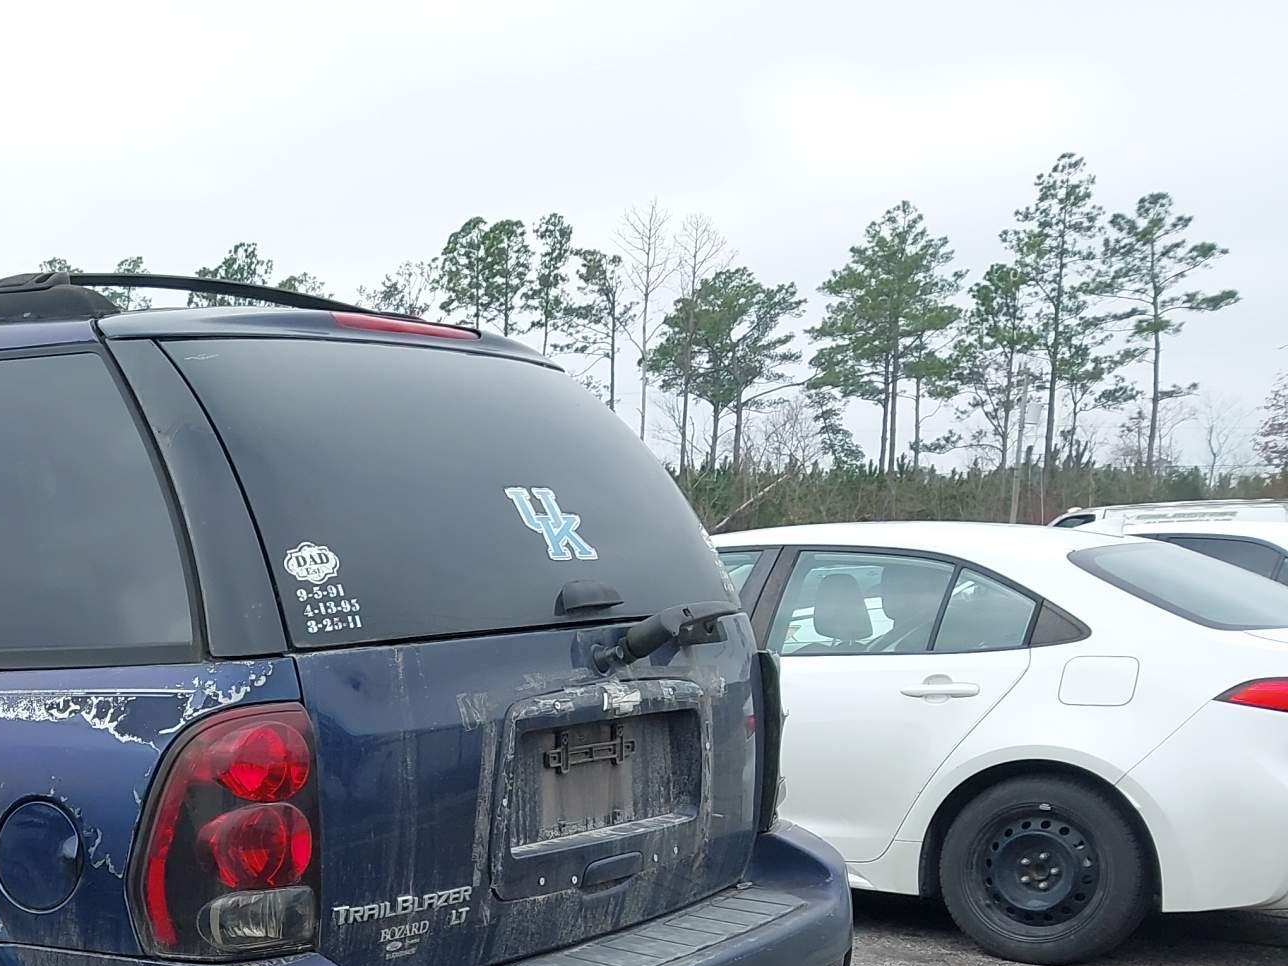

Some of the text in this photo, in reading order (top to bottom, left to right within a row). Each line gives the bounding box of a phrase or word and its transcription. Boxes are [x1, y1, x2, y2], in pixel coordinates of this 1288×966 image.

[504, 487, 599, 560] UK
[295, 552, 330, 568] DAD
[296, 584, 345, 602] 9-5-91
[303, 598, 360, 617] 4-13-95
[449, 907, 471, 926] LT
